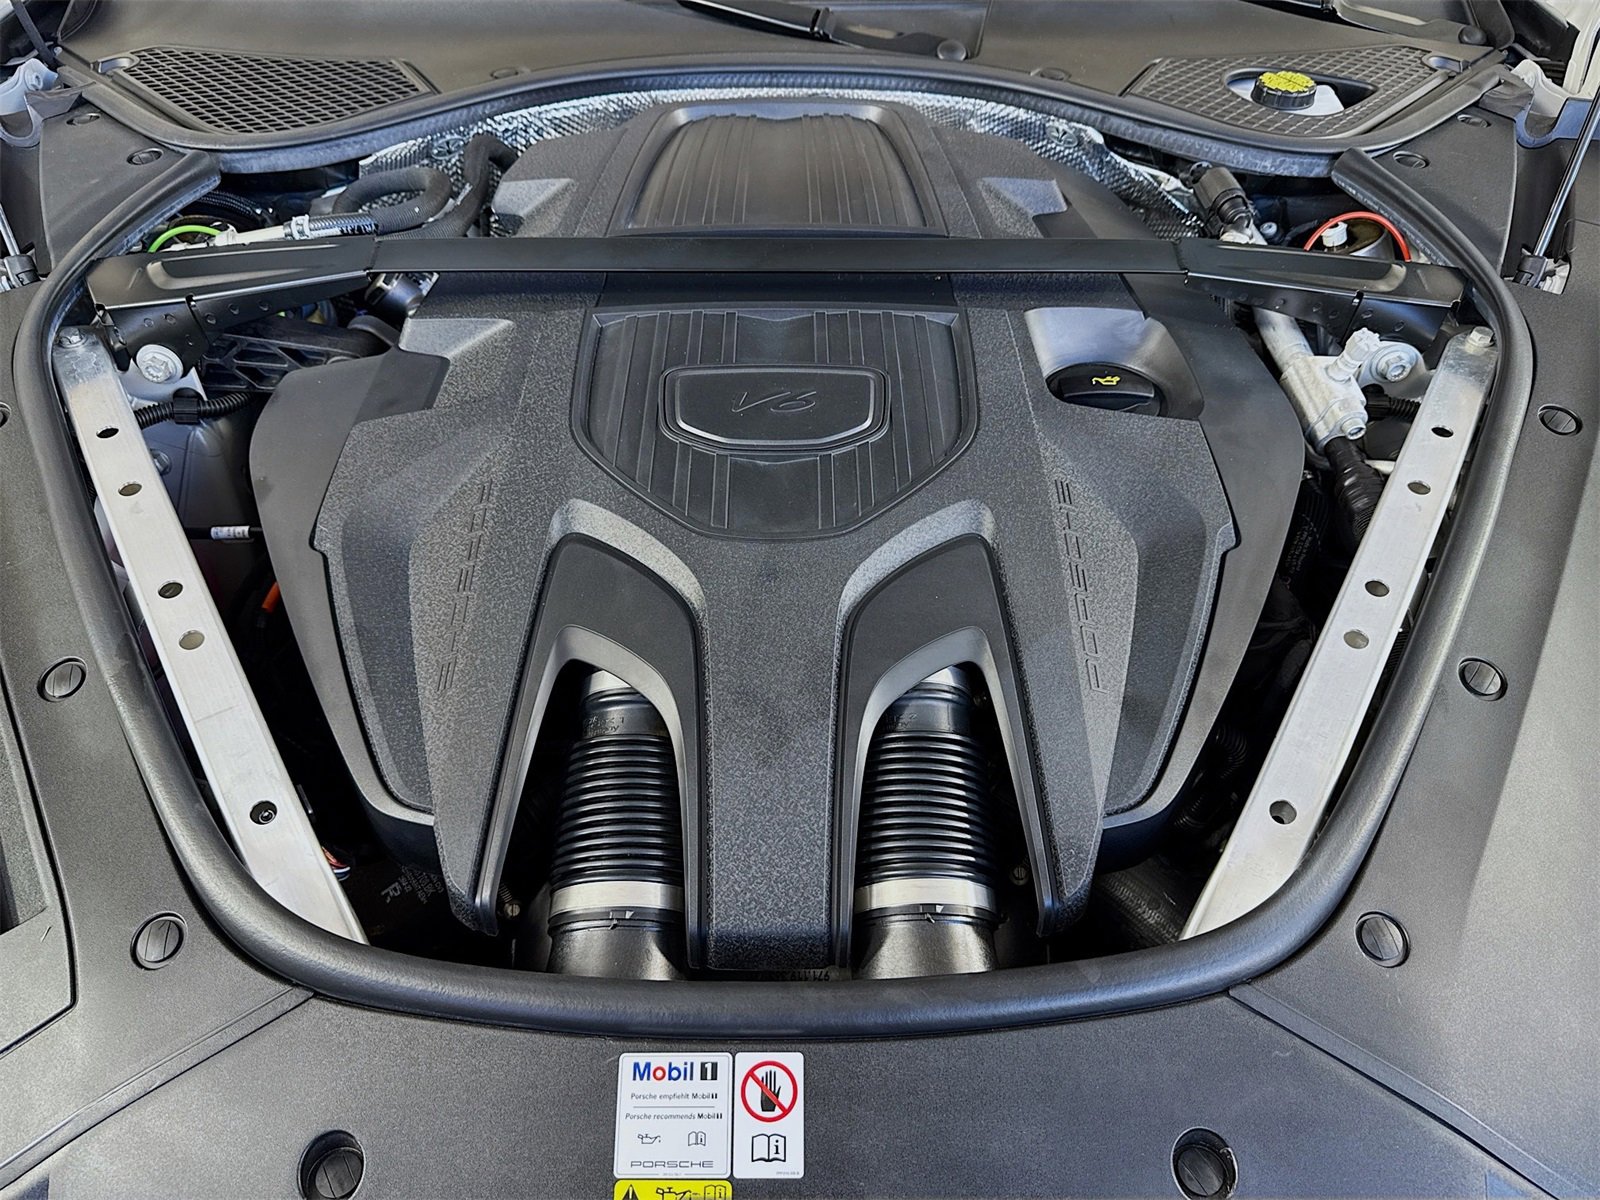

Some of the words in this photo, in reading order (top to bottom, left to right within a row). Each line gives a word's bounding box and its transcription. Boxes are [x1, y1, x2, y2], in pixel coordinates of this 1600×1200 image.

[731, 391, 817, 413] V6
[1053, 479, 1107, 694] PORSCHE
[632, 1061, 695, 1081] Mobil
[702, 1062, 716, 1080] 1
[659, 1093, 689, 1101] empfiehlt
[630, 1160, 714, 1168] PORSCHE
